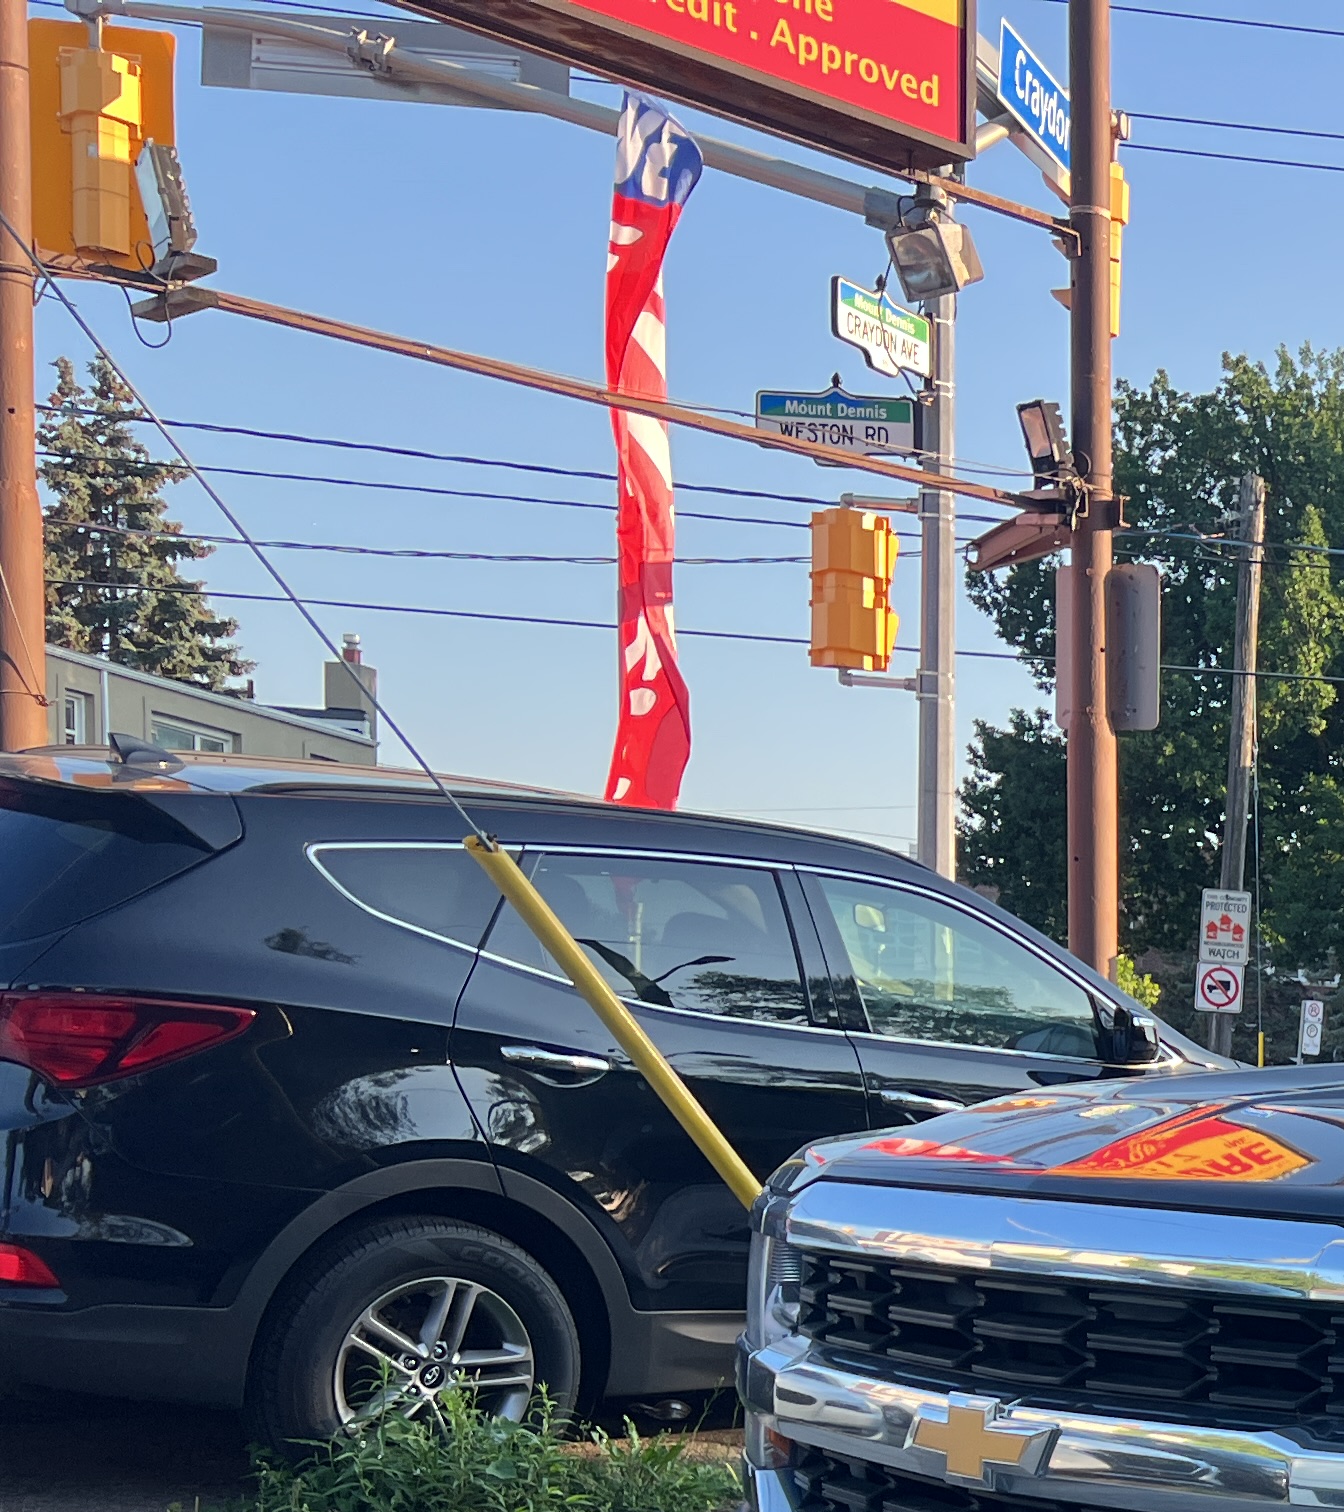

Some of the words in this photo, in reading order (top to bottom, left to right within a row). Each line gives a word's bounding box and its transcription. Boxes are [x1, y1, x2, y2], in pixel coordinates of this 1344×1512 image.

[775, 0, 833, 22] ne
[652, 0, 737, 33] edit
[770, 18, 939, 107] Approved
[854, 292, 882, 320] Mount
[885, 307, 916, 334] Dennis
[847, 311, 897, 353] CRAYDON
[901, 338, 919, 365] AVE
[785, 400, 832, 416] Mount
[838, 404, 887, 419] Dennis
[779, 422, 854, 446] WESTON
[864, 426, 889, 446] RD
[1206, 901, 1247, 913] PROTECTED
[1208, 948, 1240, 959] WATCH
